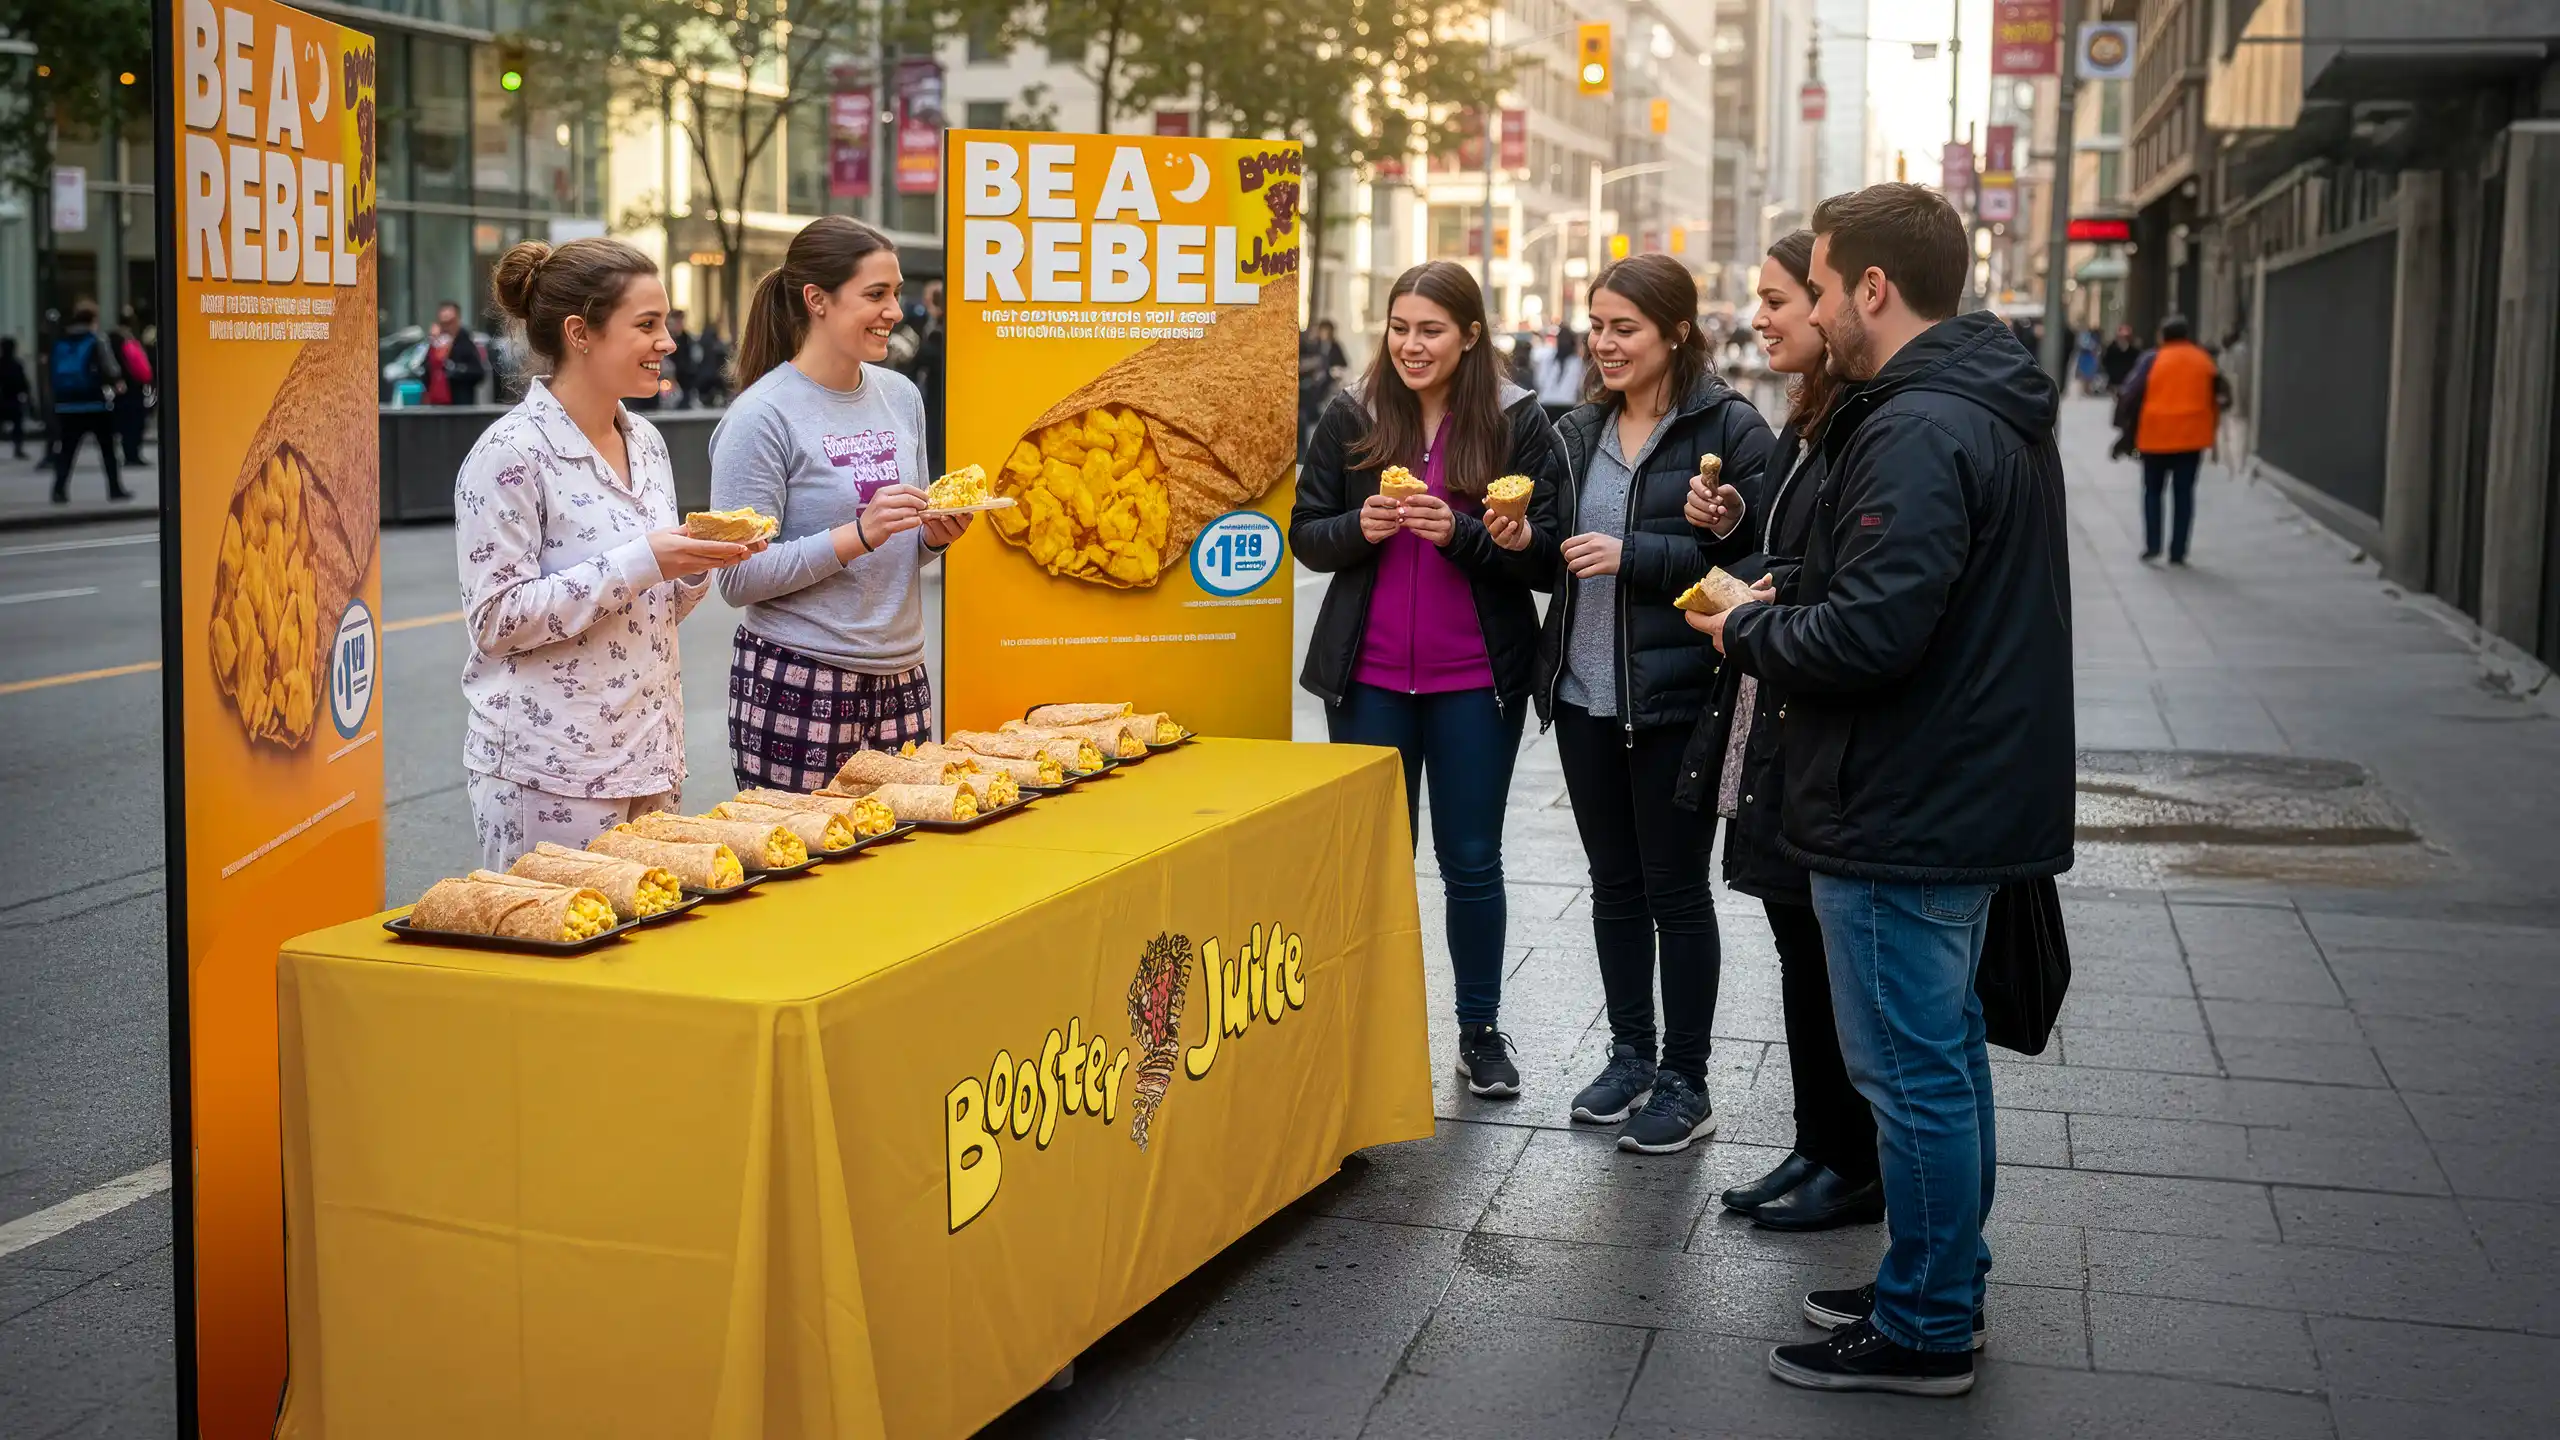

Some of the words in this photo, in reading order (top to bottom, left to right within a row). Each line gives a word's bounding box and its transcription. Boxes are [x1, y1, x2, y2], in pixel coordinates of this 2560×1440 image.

[184, 0, 256, 140] BE
[266, 24, 304, 150] A
[185, 133, 357, 287] REBEL
[964, 141, 1076, 219] BE
[1094, 146, 1161, 221] A
[963, 219, 1260, 304] REBEL
[945, 1016, 1129, 1235] Booster
